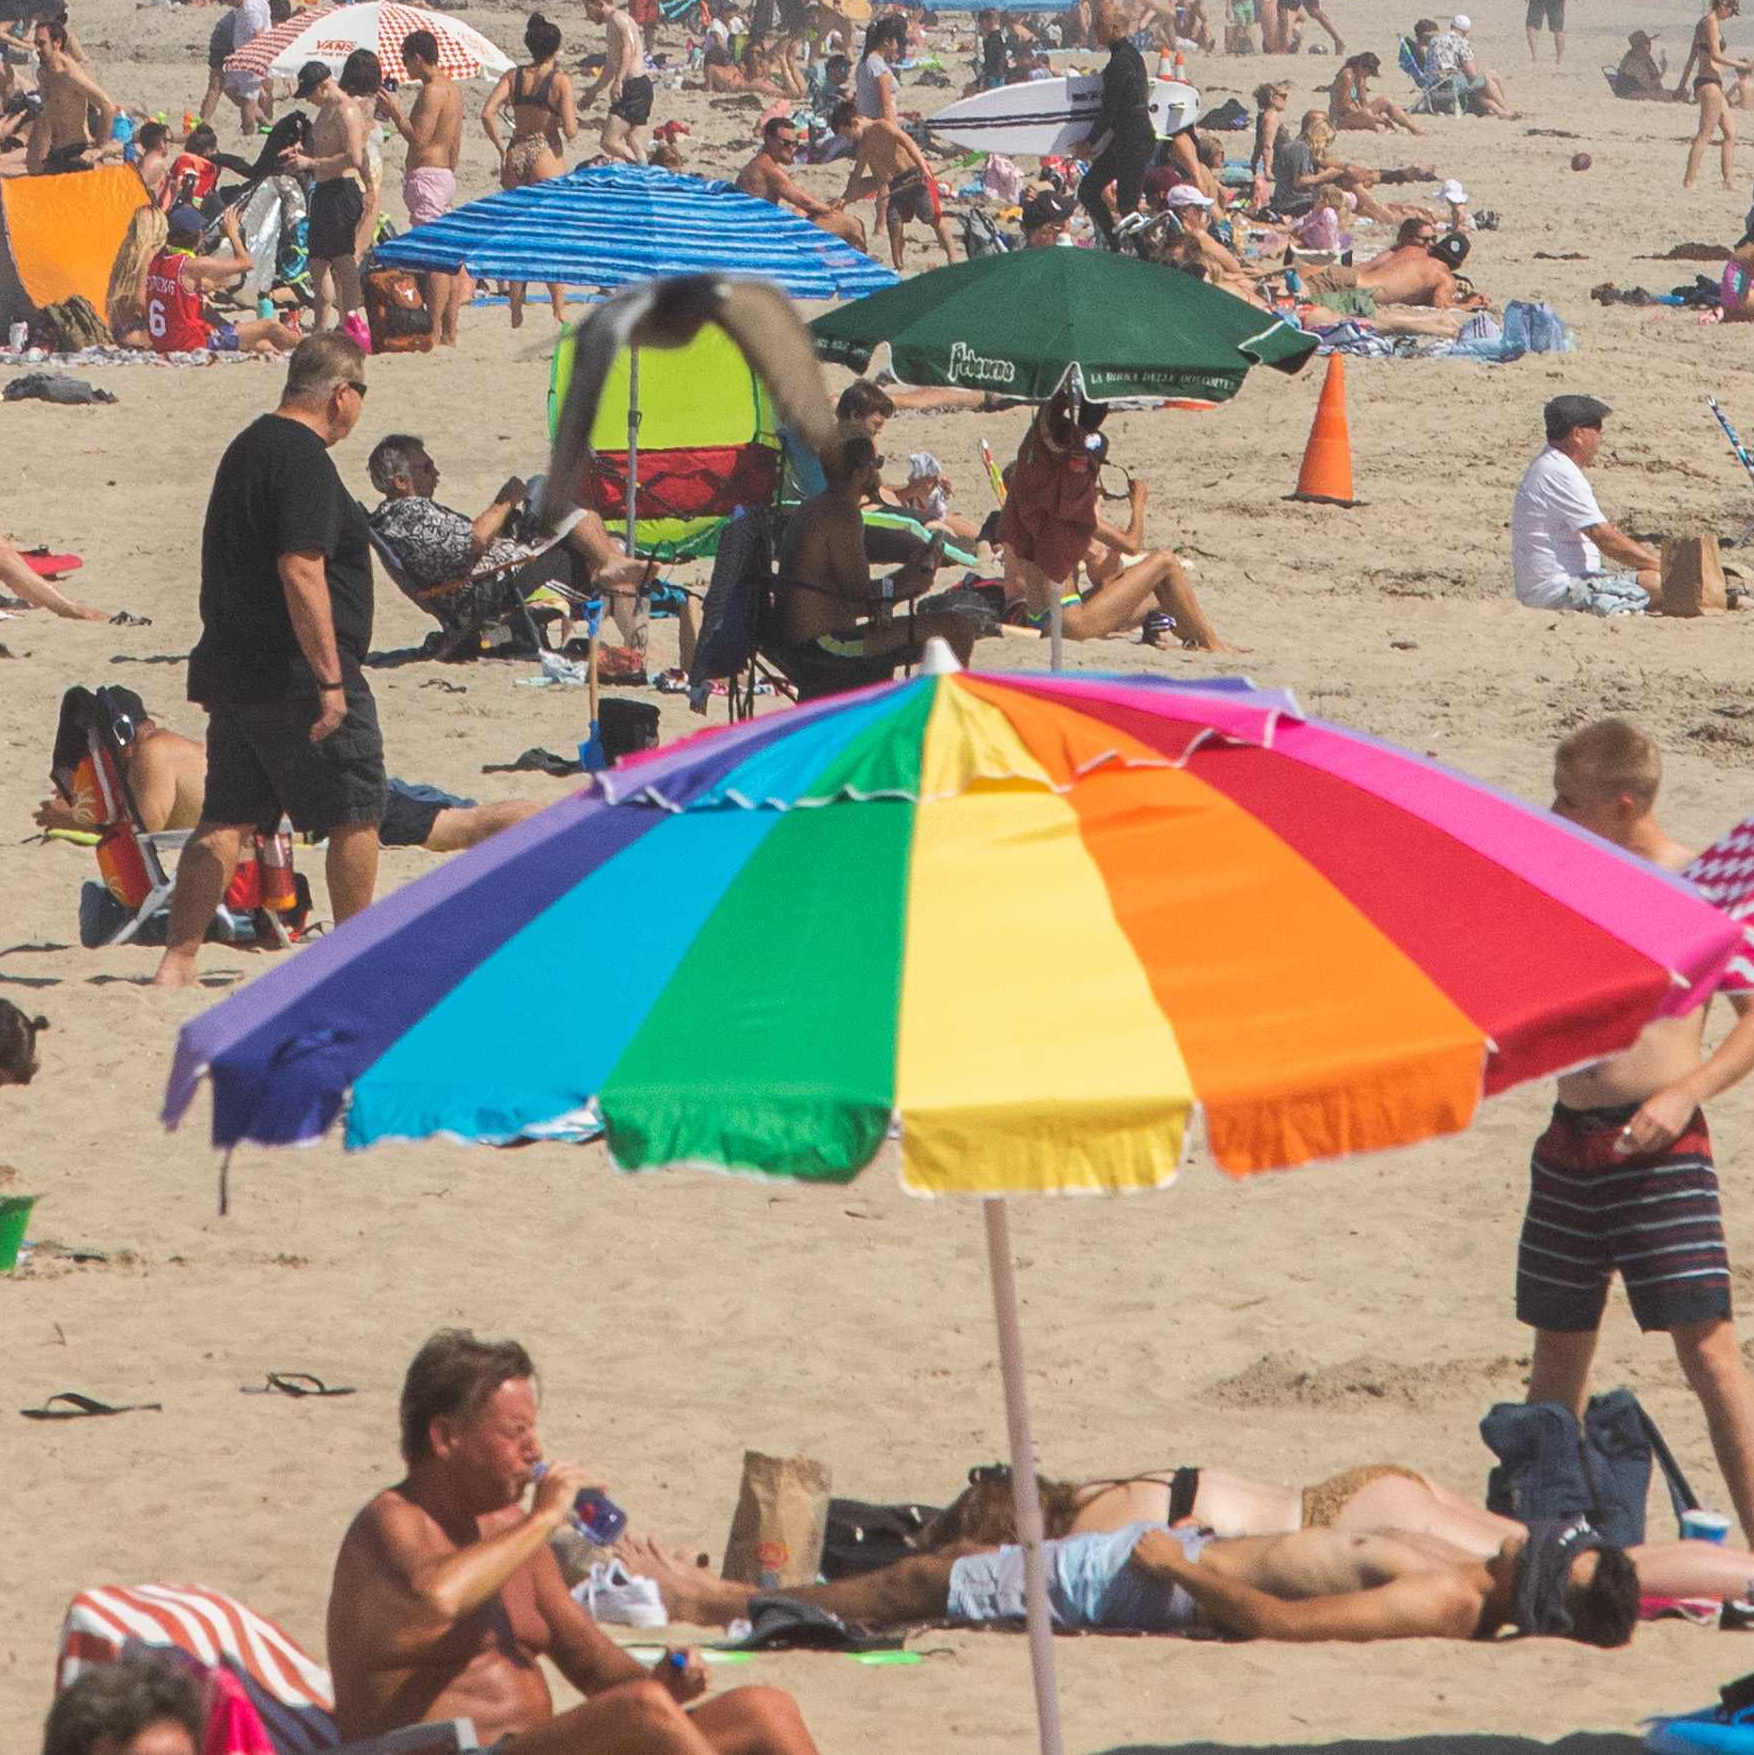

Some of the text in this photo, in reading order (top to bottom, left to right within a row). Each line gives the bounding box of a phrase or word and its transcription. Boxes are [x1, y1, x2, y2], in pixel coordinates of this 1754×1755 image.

[316, 39, 358, 52] VANS
[149, 299, 166, 337] 6
[1090, 372, 1103, 385] LA
